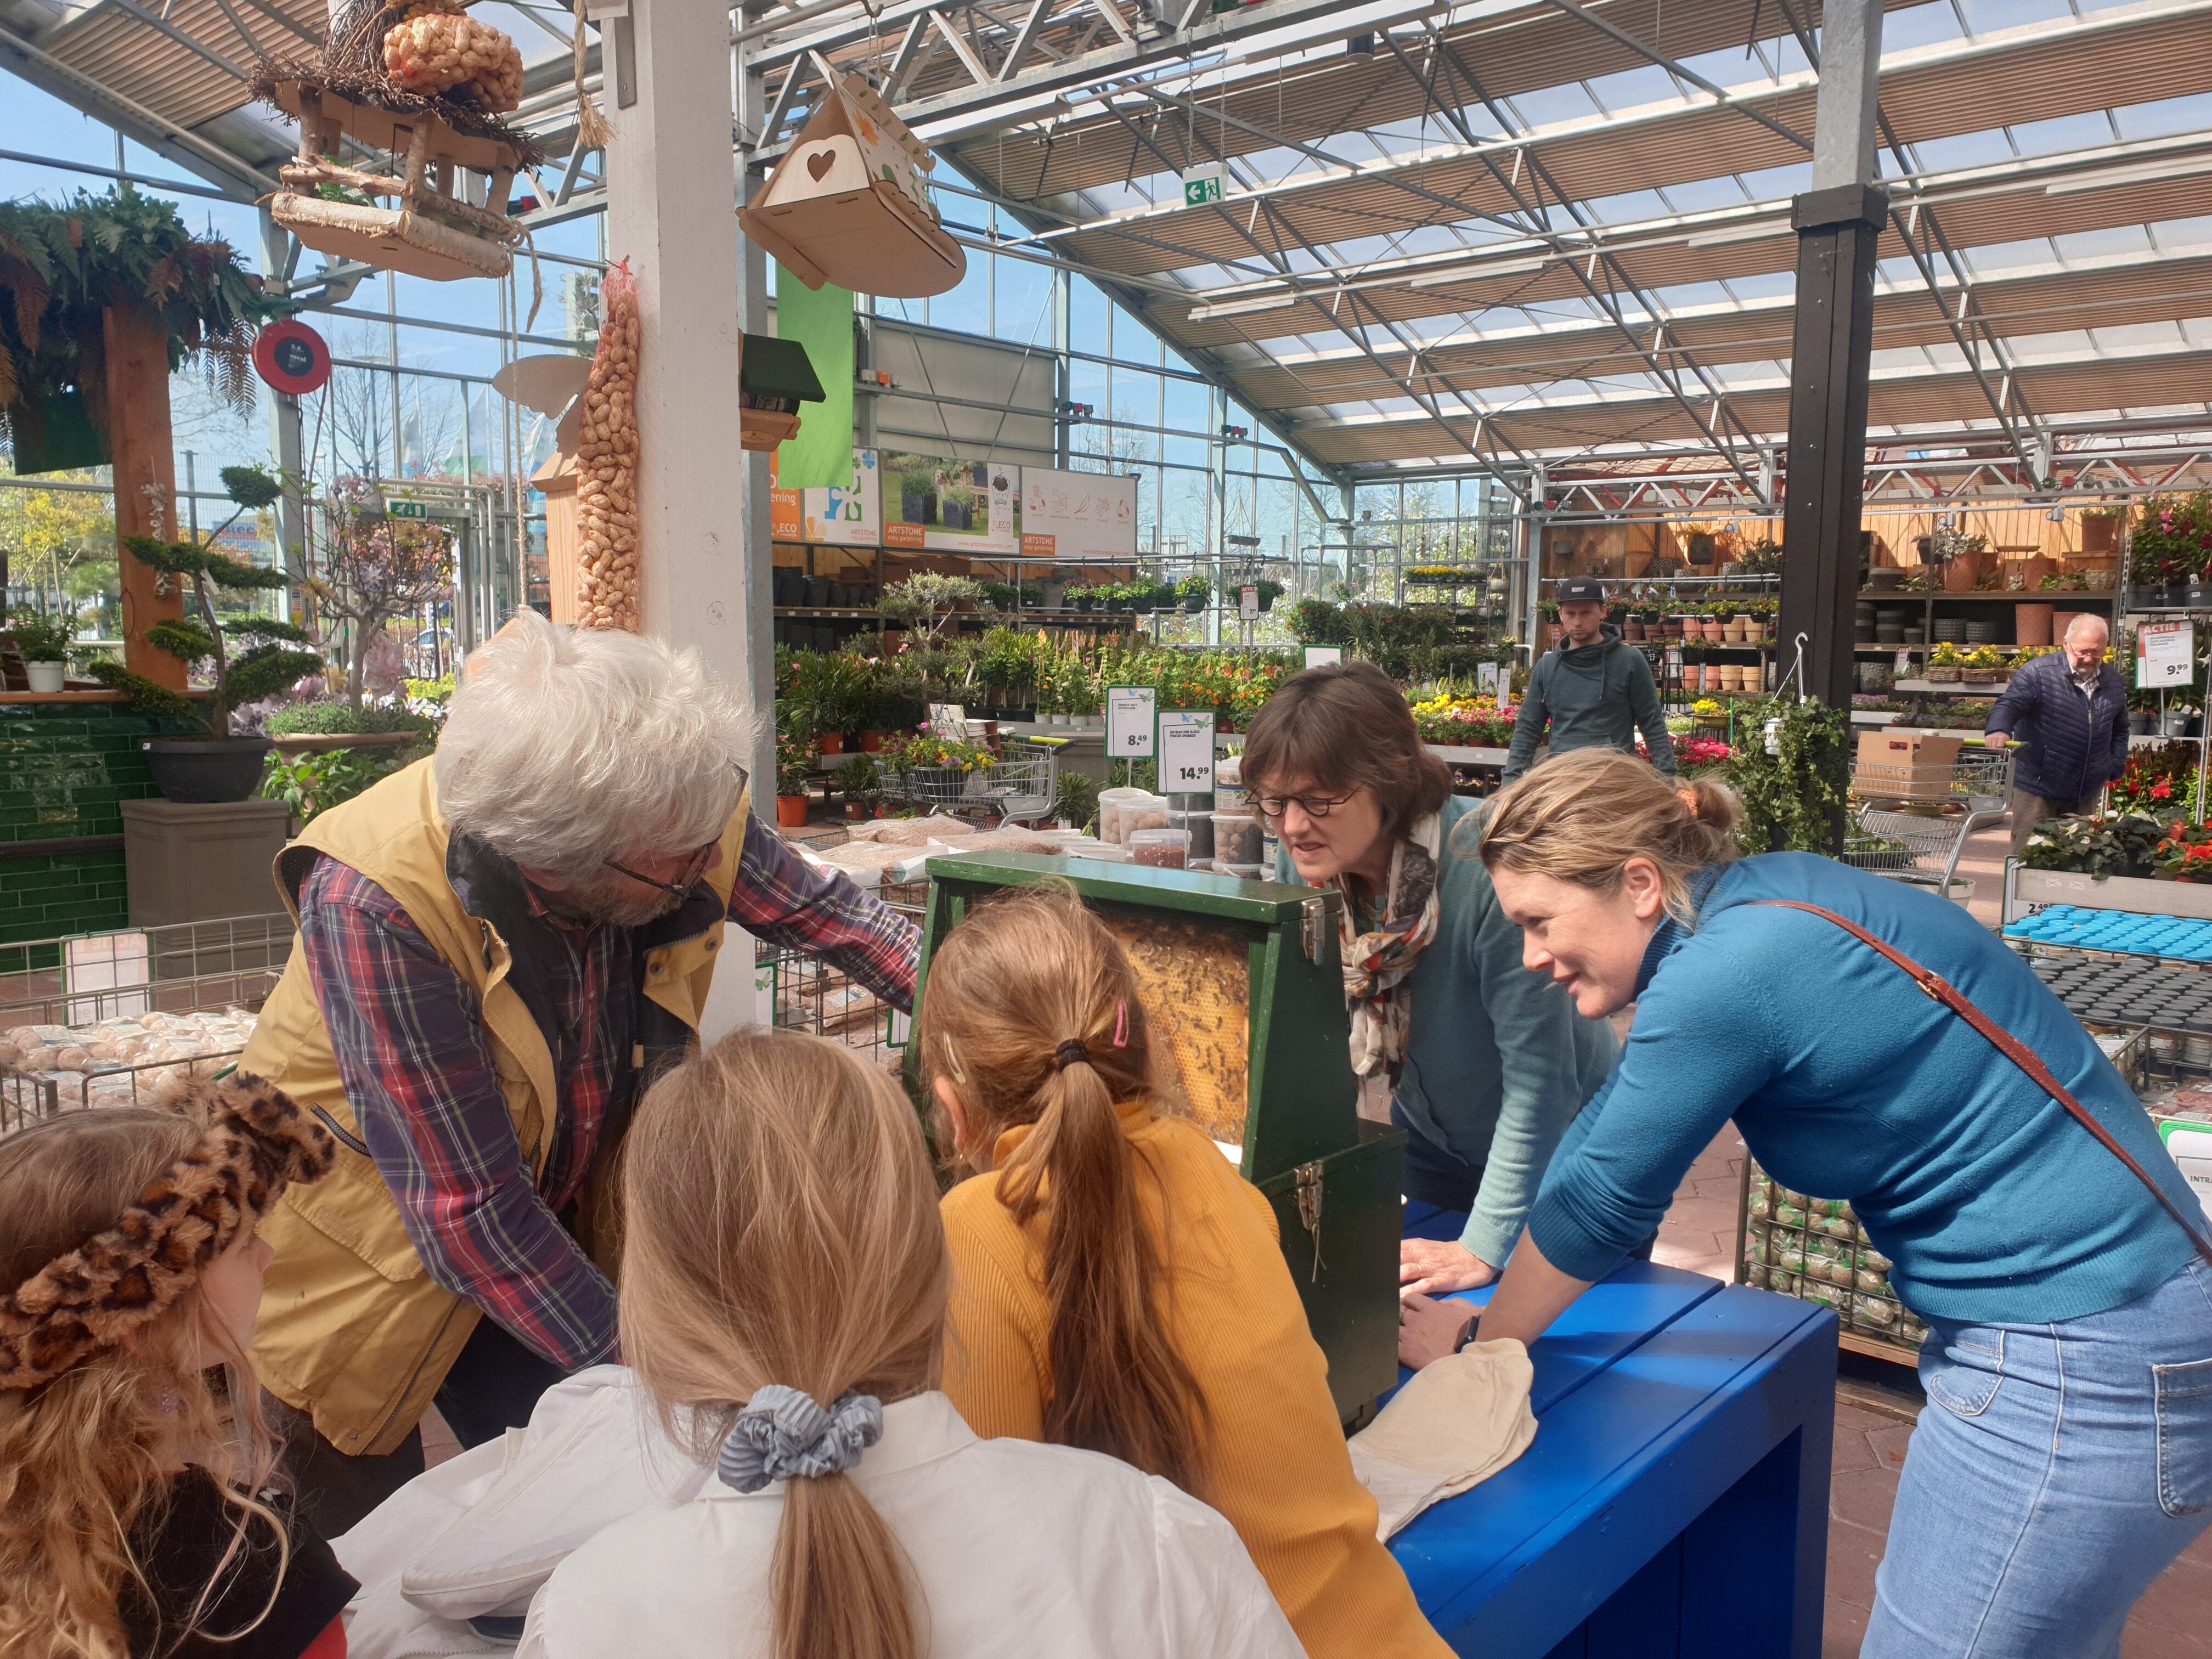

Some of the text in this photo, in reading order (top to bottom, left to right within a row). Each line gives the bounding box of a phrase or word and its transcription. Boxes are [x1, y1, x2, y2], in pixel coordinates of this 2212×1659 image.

[770, 492, 796, 506] ening
[780, 523, 797, 533] ECO
[888, 525, 922, 536] ARTSTONE
[998, 521, 1011, 529] ECO
[1024, 535, 1053, 545] ARTSTONE
[2143, 623, 2176, 634] ACTIE
[2166, 663, 2188, 675] 9.99
[1127, 735, 1148, 746] 8.49
[1180, 766, 1209, 780] 14.99
[2028, 903, 2049, 914] 249
